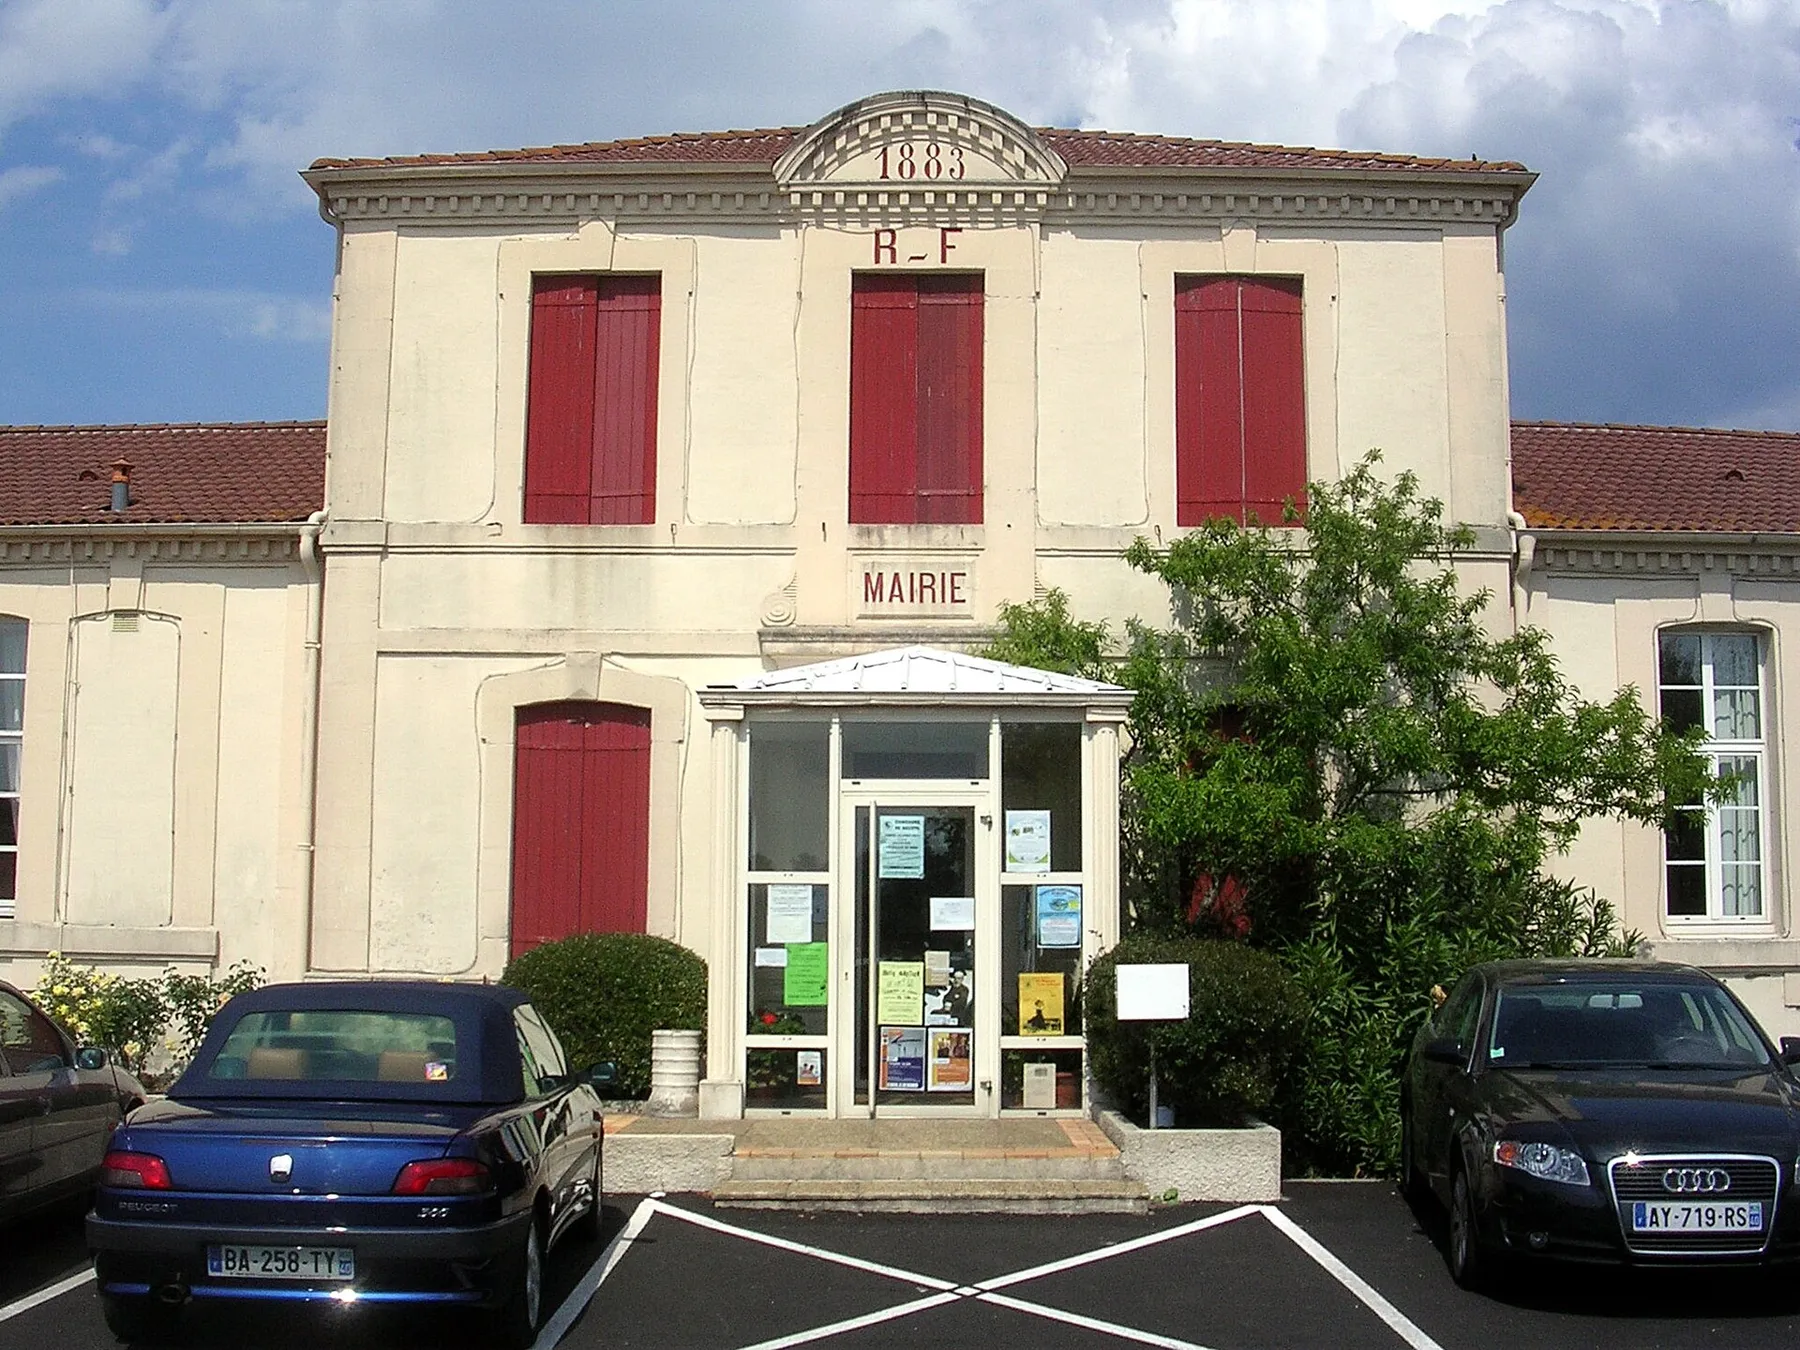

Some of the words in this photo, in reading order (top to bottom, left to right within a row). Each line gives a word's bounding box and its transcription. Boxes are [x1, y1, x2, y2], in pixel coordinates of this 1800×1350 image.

[874, 142, 965, 181] 1883
[864, 572, 967, 604] MAIRIE
[118, 1201, 179, 1213] PEUGEOT
[1648, 1207, 1747, 1228] AY-719-RS
[224, 1249, 336, 1274] BA-258-TY
